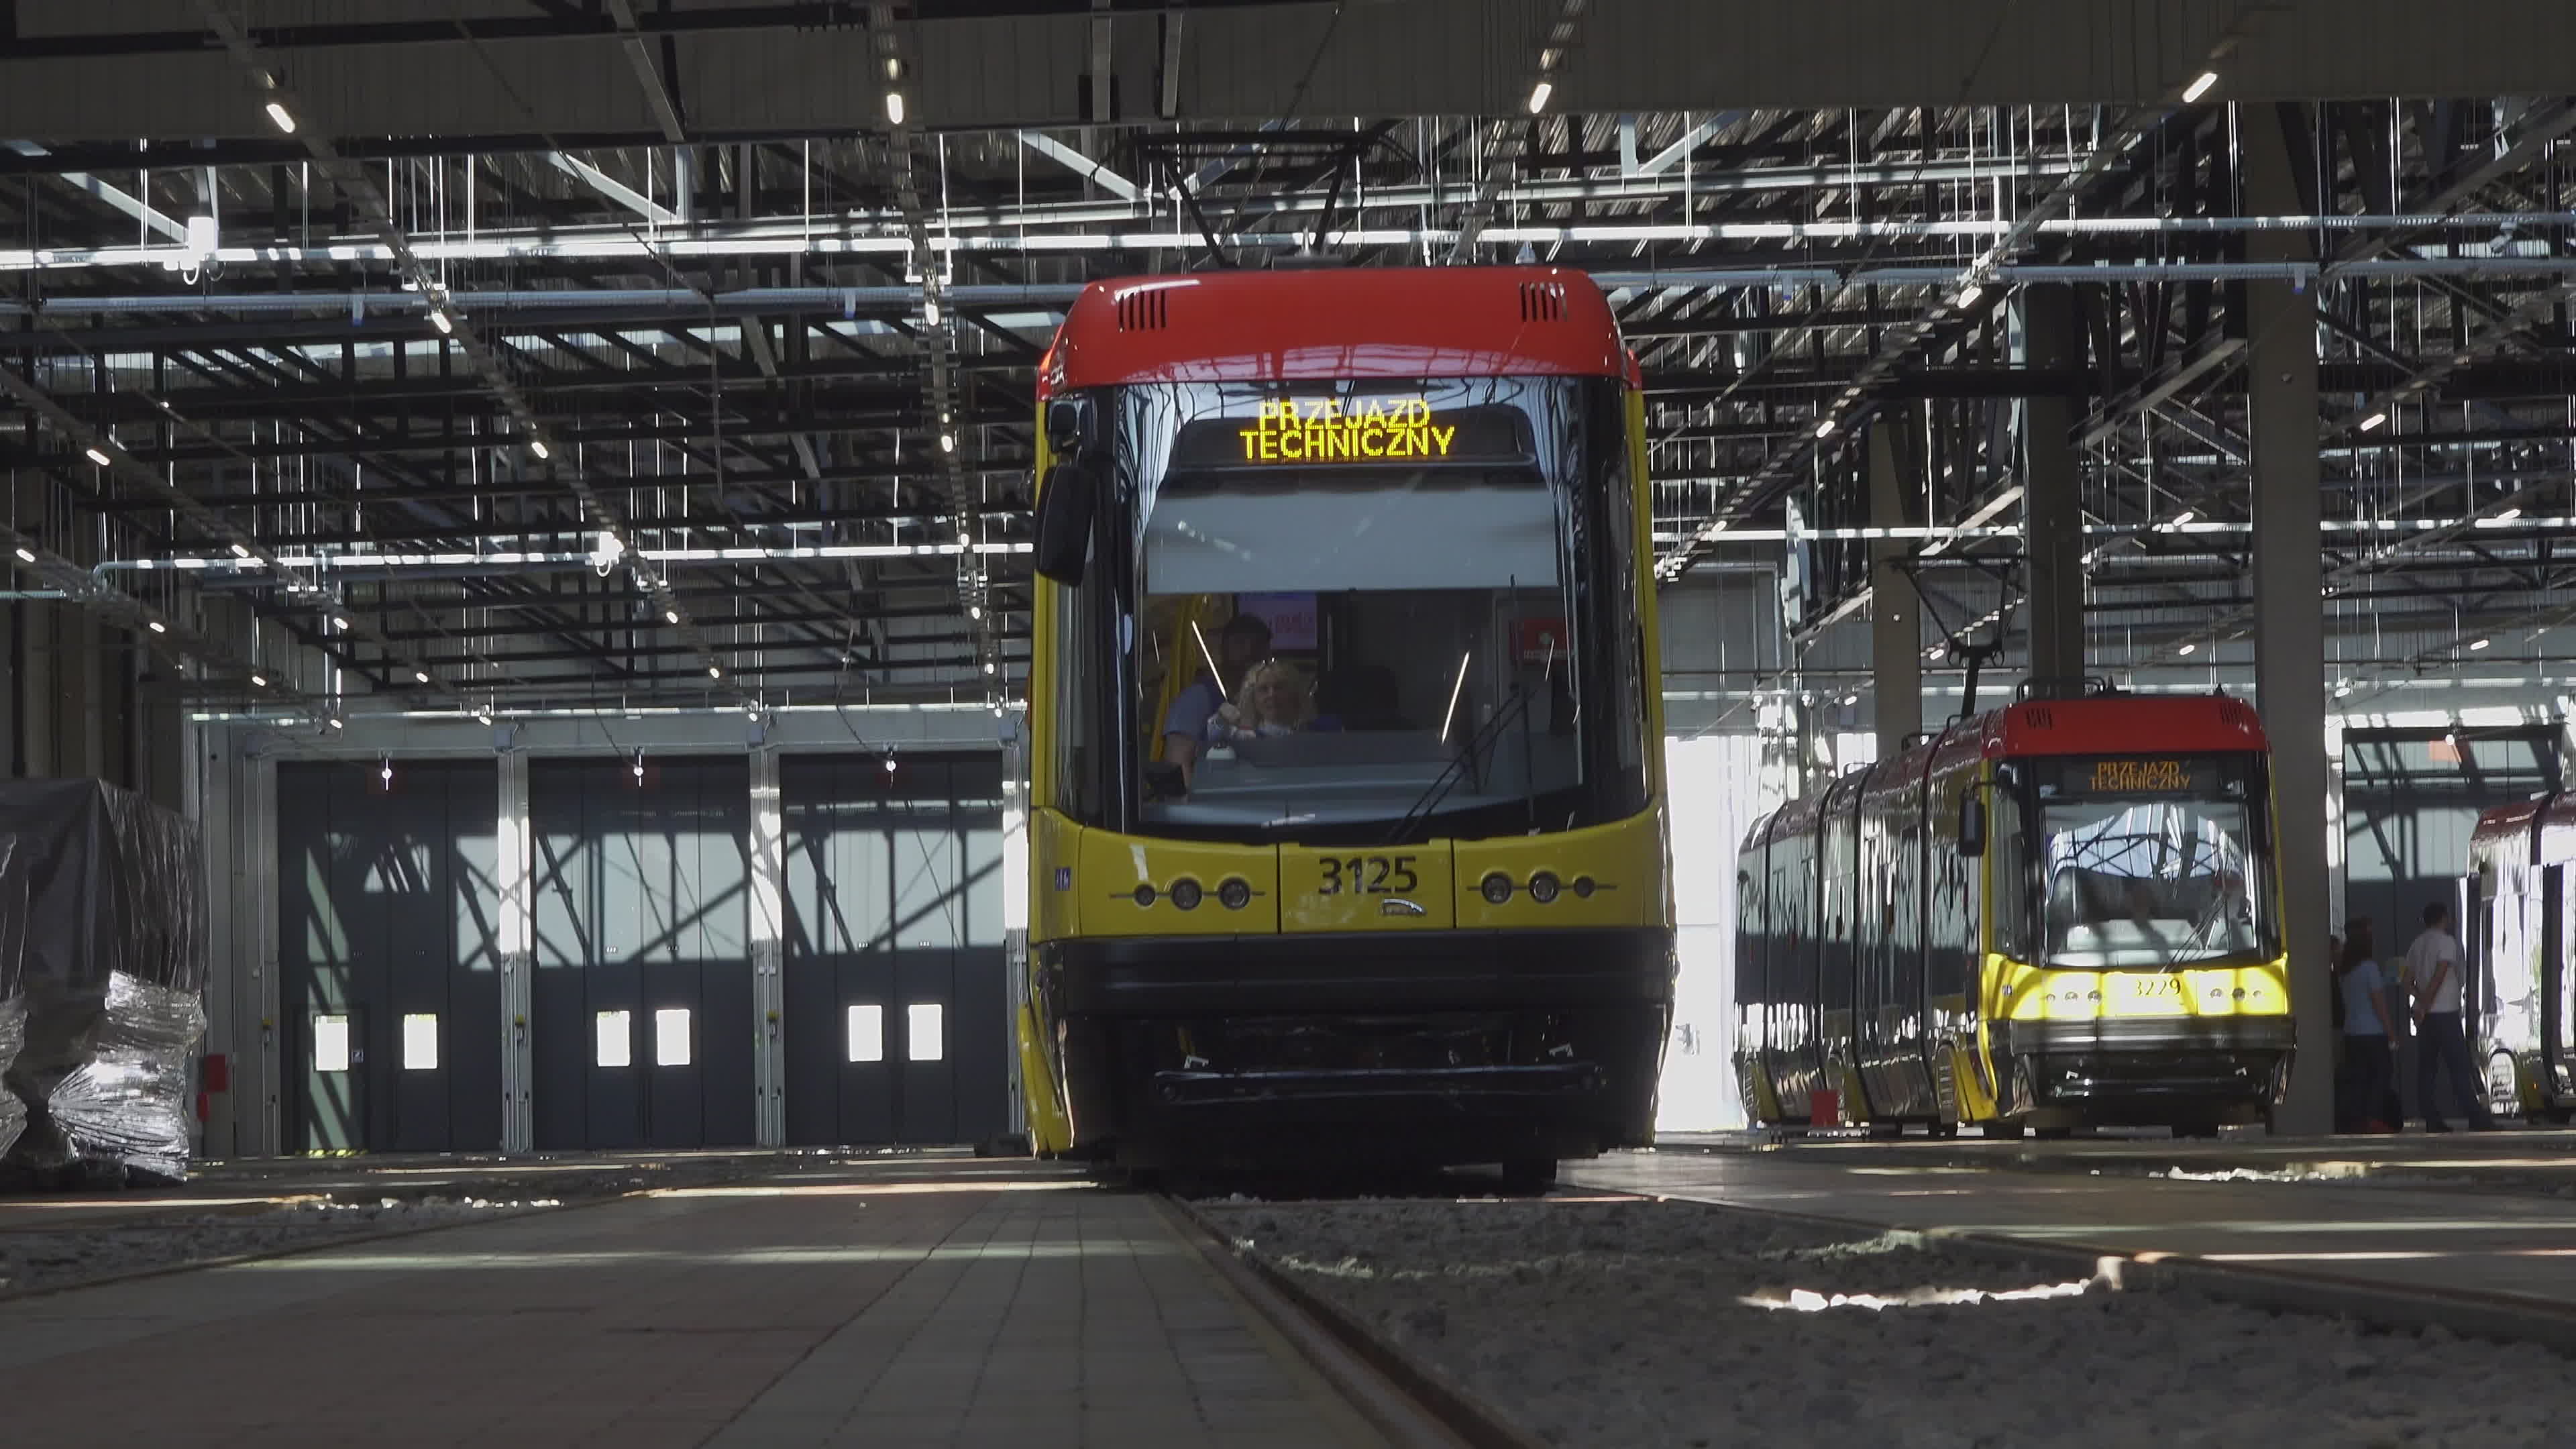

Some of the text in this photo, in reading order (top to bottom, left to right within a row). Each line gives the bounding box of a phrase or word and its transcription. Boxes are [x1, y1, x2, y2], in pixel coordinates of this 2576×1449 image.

[1259, 398, 1431, 430] PRZEJAZD
[1239, 426, 1455, 460] TECHNICZNY
[2090, 775, 2190, 791] TECHNICZNY
[2098, 761, 2180, 779] PRZEJAZD
[1319, 855, 1417, 895] 3125
